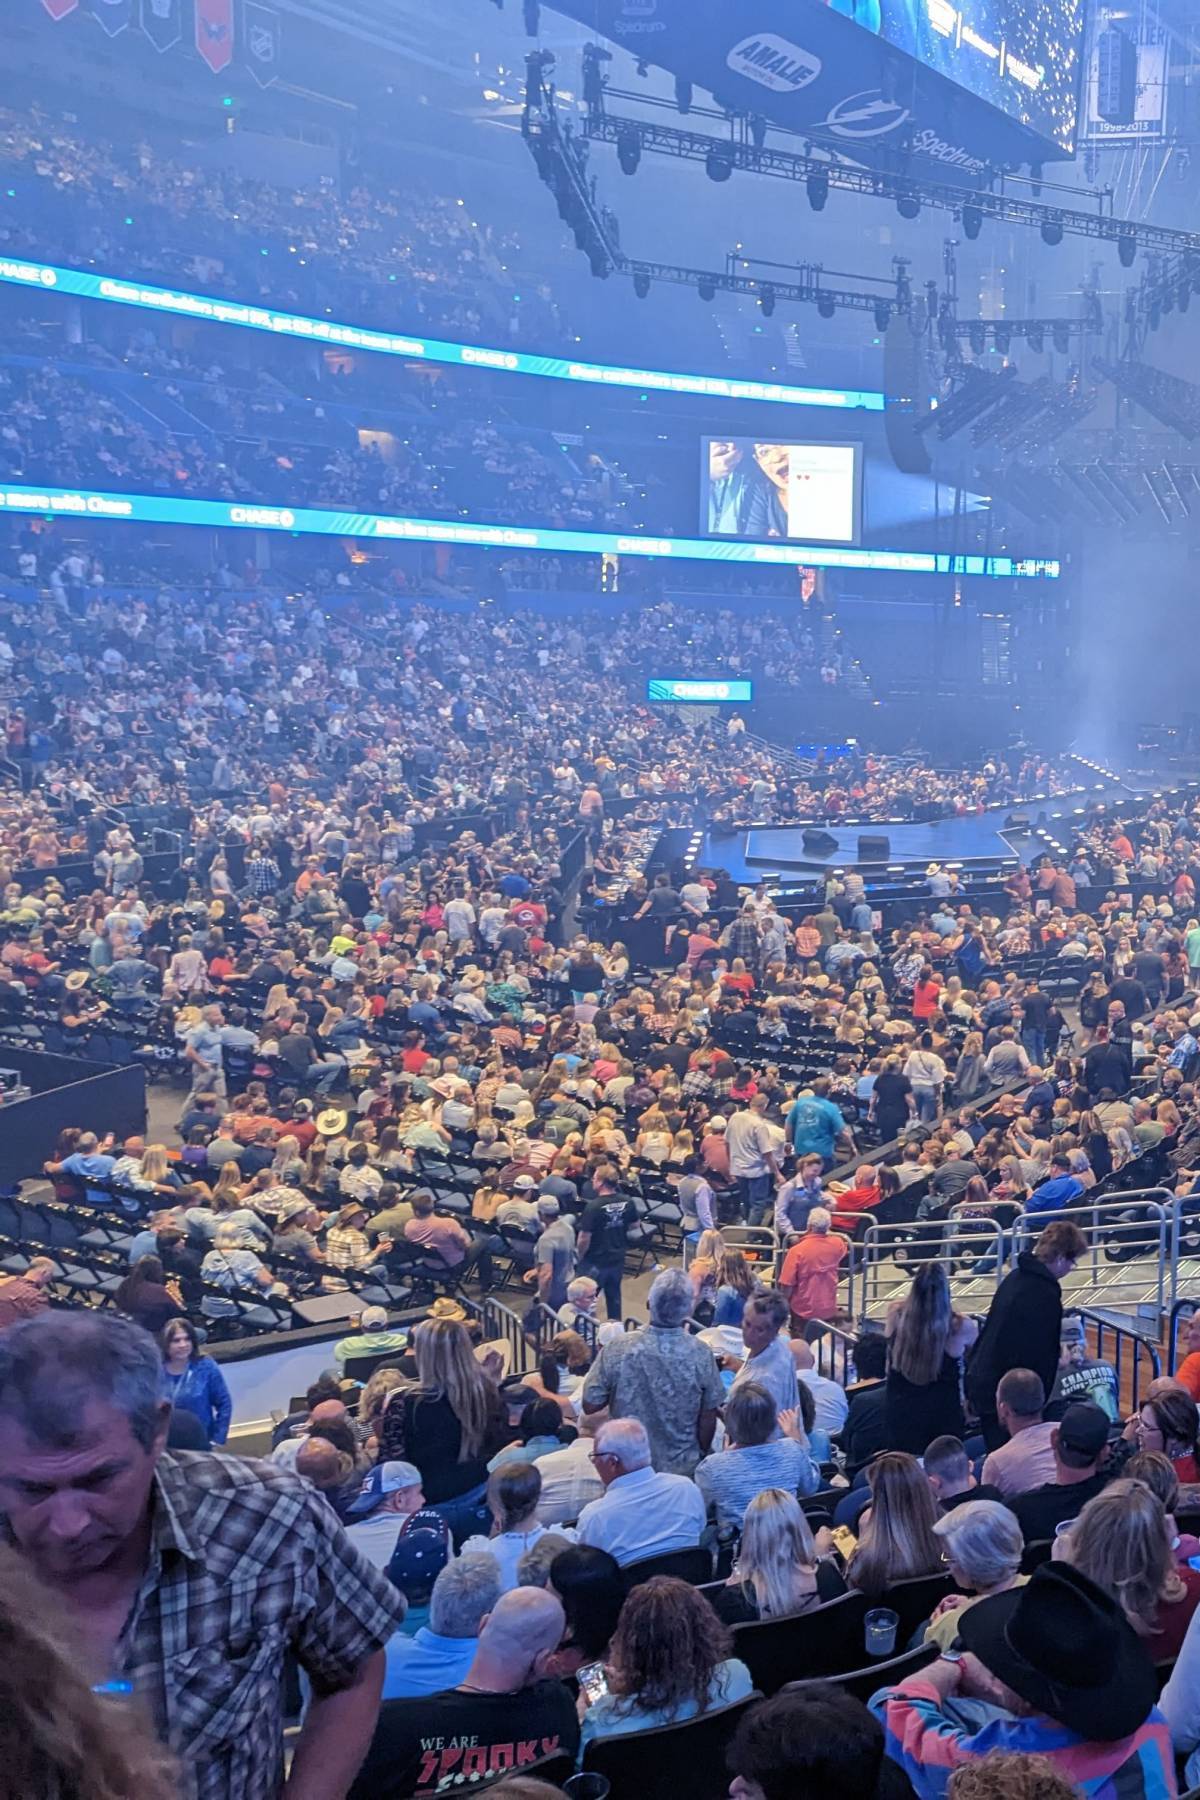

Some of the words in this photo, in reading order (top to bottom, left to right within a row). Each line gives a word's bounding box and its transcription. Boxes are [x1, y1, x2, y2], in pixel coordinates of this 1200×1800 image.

[735, 41, 815, 86] AMALIE
[0, 263, 41, 283] HASE
[231, 508, 281, 524] CHASE
[420, 1737, 446, 1751] WE
[449, 1735, 479, 1749] ARE
[416, 1734, 560, 1784] SPOOKY
